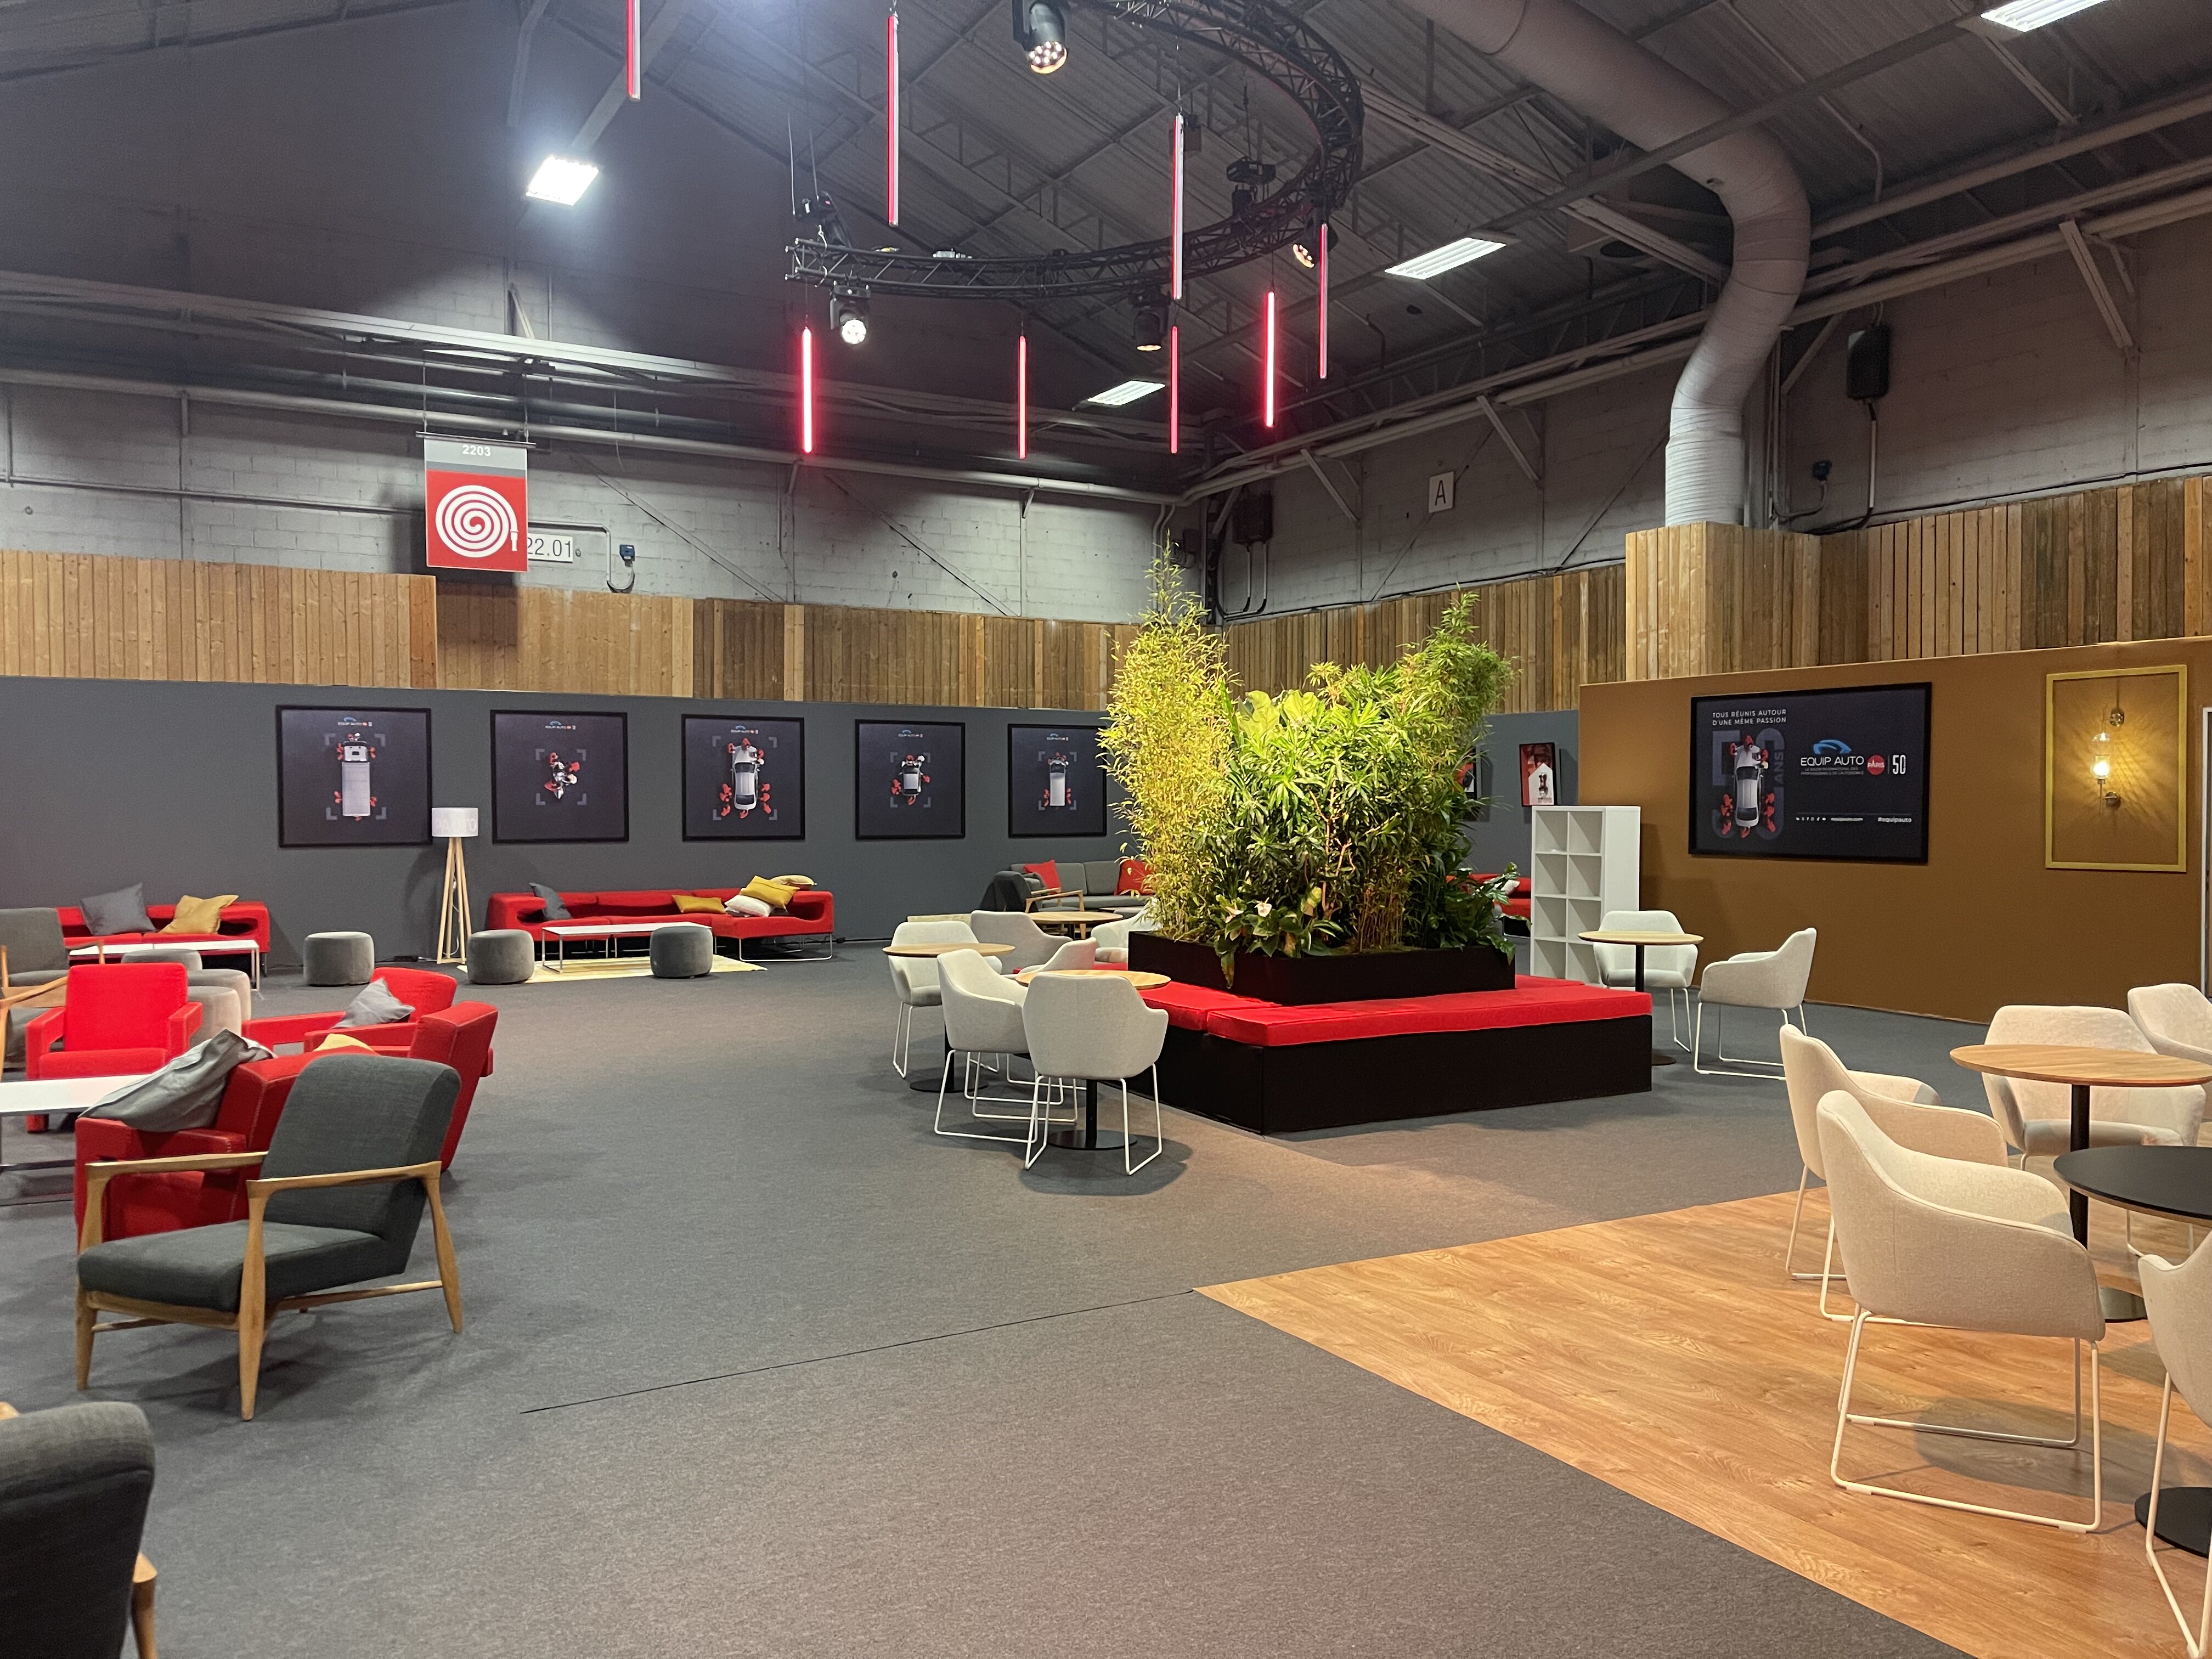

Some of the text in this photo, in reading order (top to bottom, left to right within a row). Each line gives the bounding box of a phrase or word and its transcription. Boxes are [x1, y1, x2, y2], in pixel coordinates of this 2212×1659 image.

[462, 444, 491, 456] 2203
[1435, 480, 1446, 505] A
[527, 537, 571, 557] 22.01
[1801, 756, 1864, 766] EQUIP AUTO
[1893, 754, 1906, 774] 50
